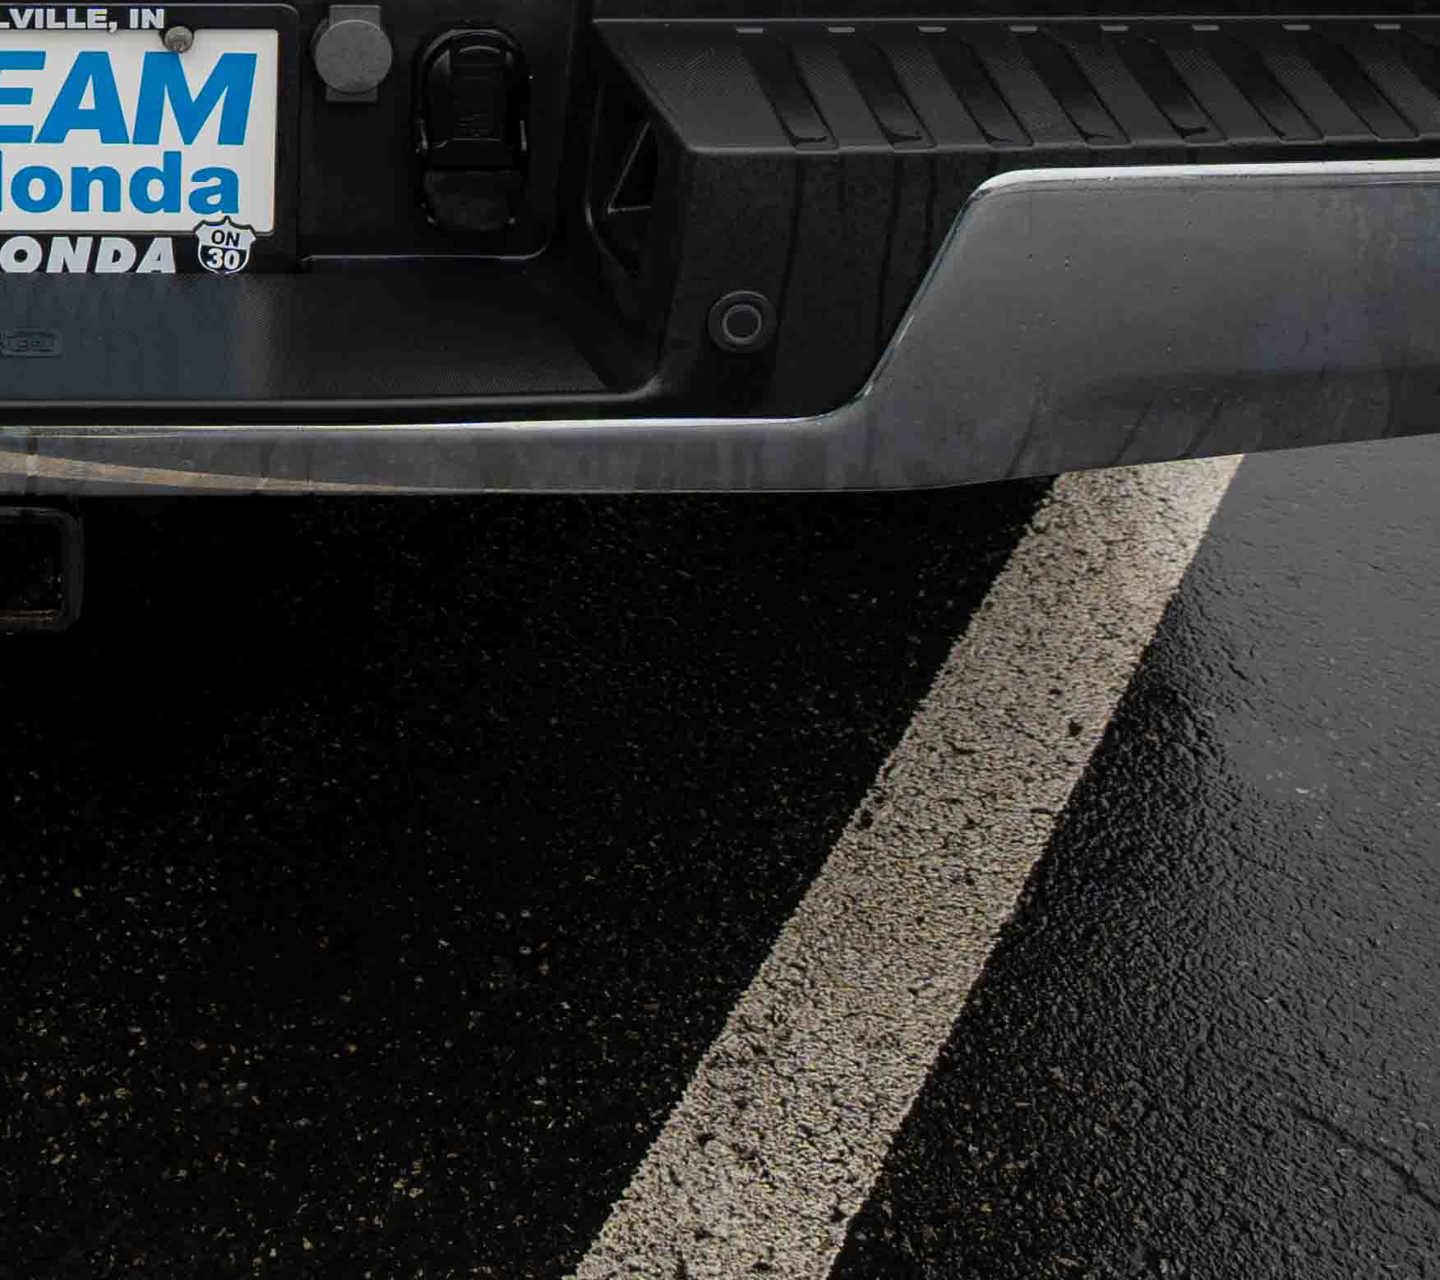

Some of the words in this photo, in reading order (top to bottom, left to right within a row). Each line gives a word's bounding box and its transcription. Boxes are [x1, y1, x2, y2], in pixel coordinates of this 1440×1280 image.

[130, 8, 165, 30] IN
[211, 229, 241, 247] ON
[206, 247, 240, 270] 30
